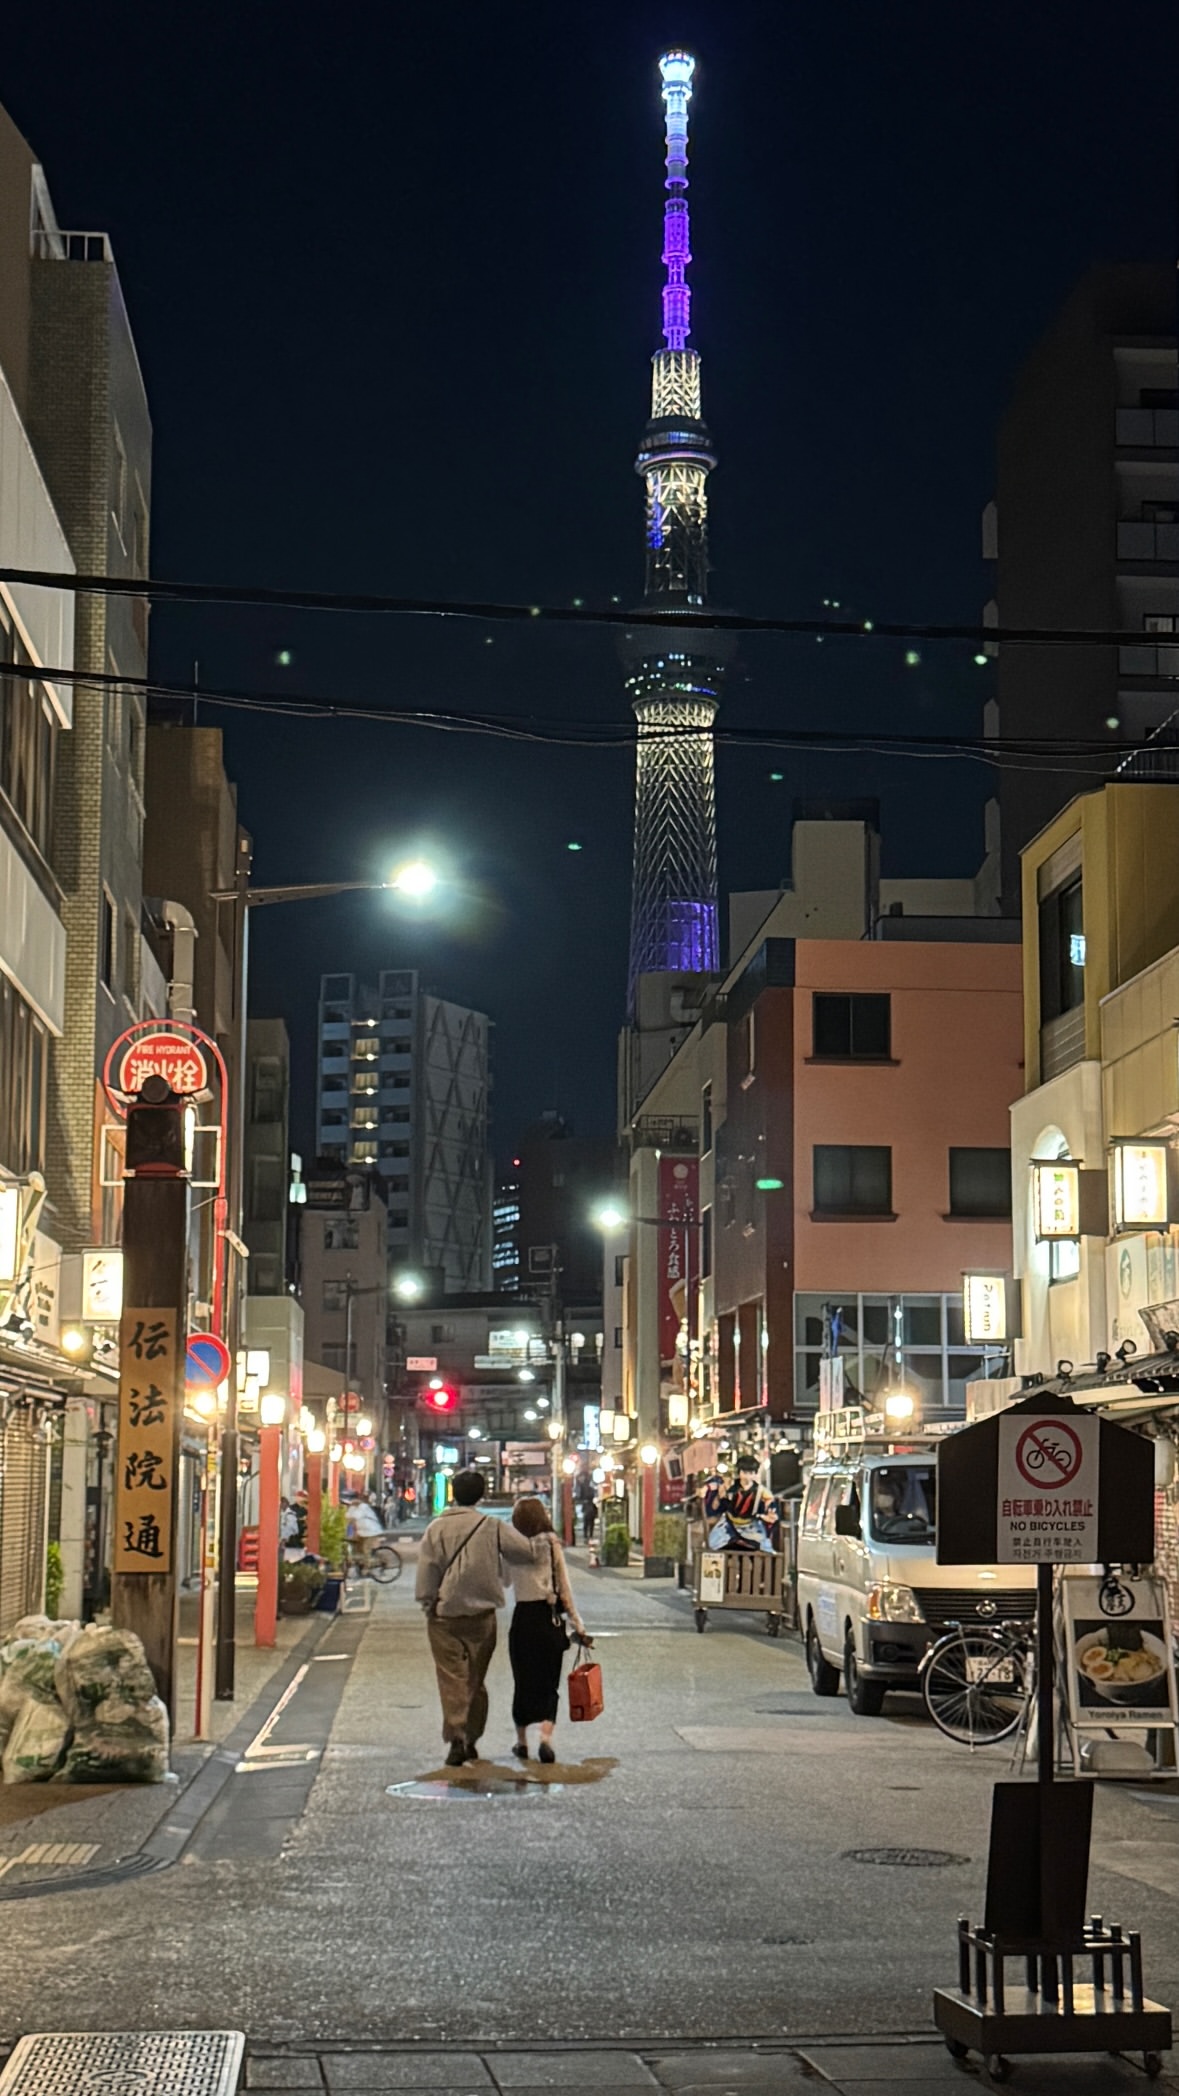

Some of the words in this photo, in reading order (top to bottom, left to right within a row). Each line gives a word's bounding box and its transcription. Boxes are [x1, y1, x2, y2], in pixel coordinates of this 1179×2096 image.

[137, 1045, 154, 1054] FIRE
[156, 1045, 191, 1055] HYDRANT
[123, 1321, 170, 1559] 伝法院通
[1002, 1499, 1093, 1517] 自転車乗り入れ禁止
[1010, 1521, 1026, 1531] NO
[1030, 1521, 1085, 1531] BICYCLES
[1088, 1710, 1126, 1721] Yoroiya
[1129, 1710, 1163, 1719] Ramen
